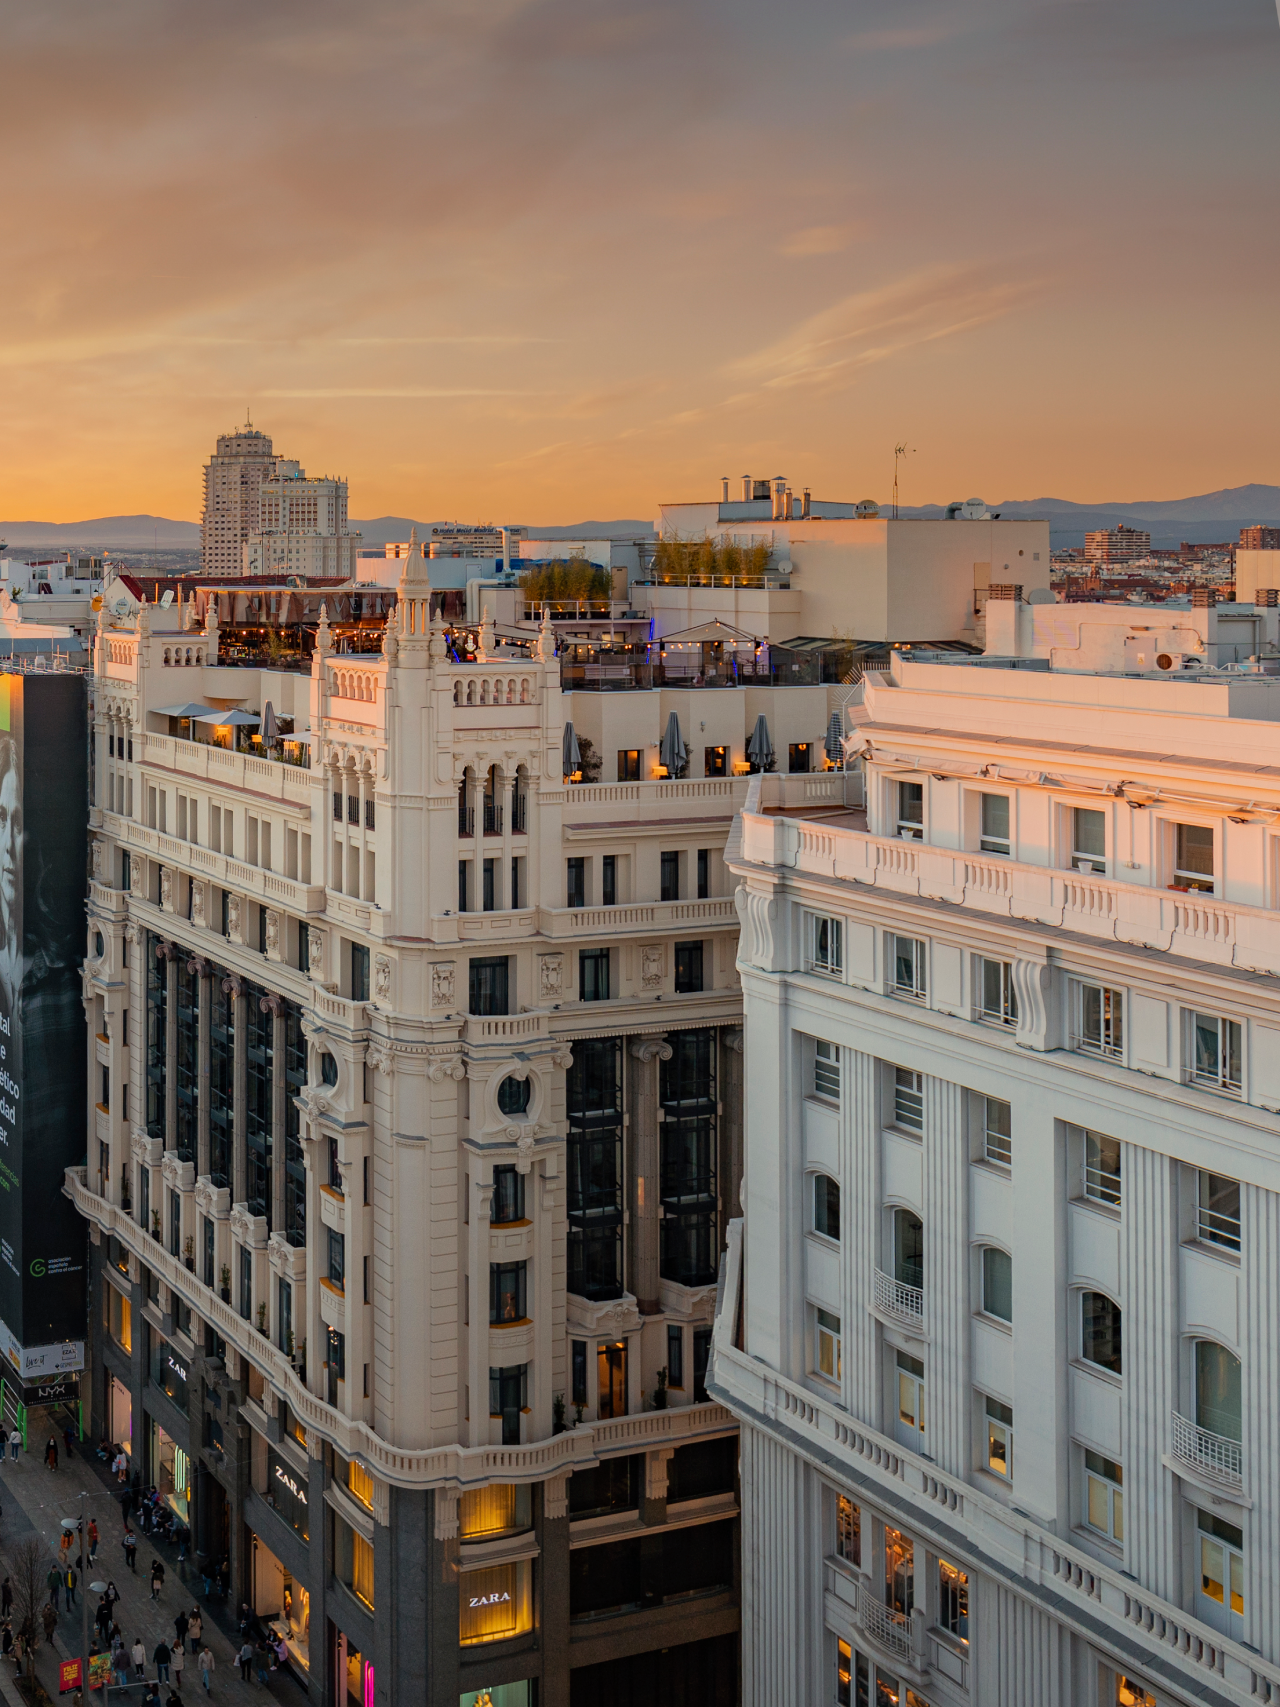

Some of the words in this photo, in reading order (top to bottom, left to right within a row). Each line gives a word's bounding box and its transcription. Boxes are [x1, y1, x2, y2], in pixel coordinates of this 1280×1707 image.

[39, 1385, 65, 1398] NYX
[275, 1465, 307, 1504] ZARA
[469, 1592, 510, 1607] ZARA
